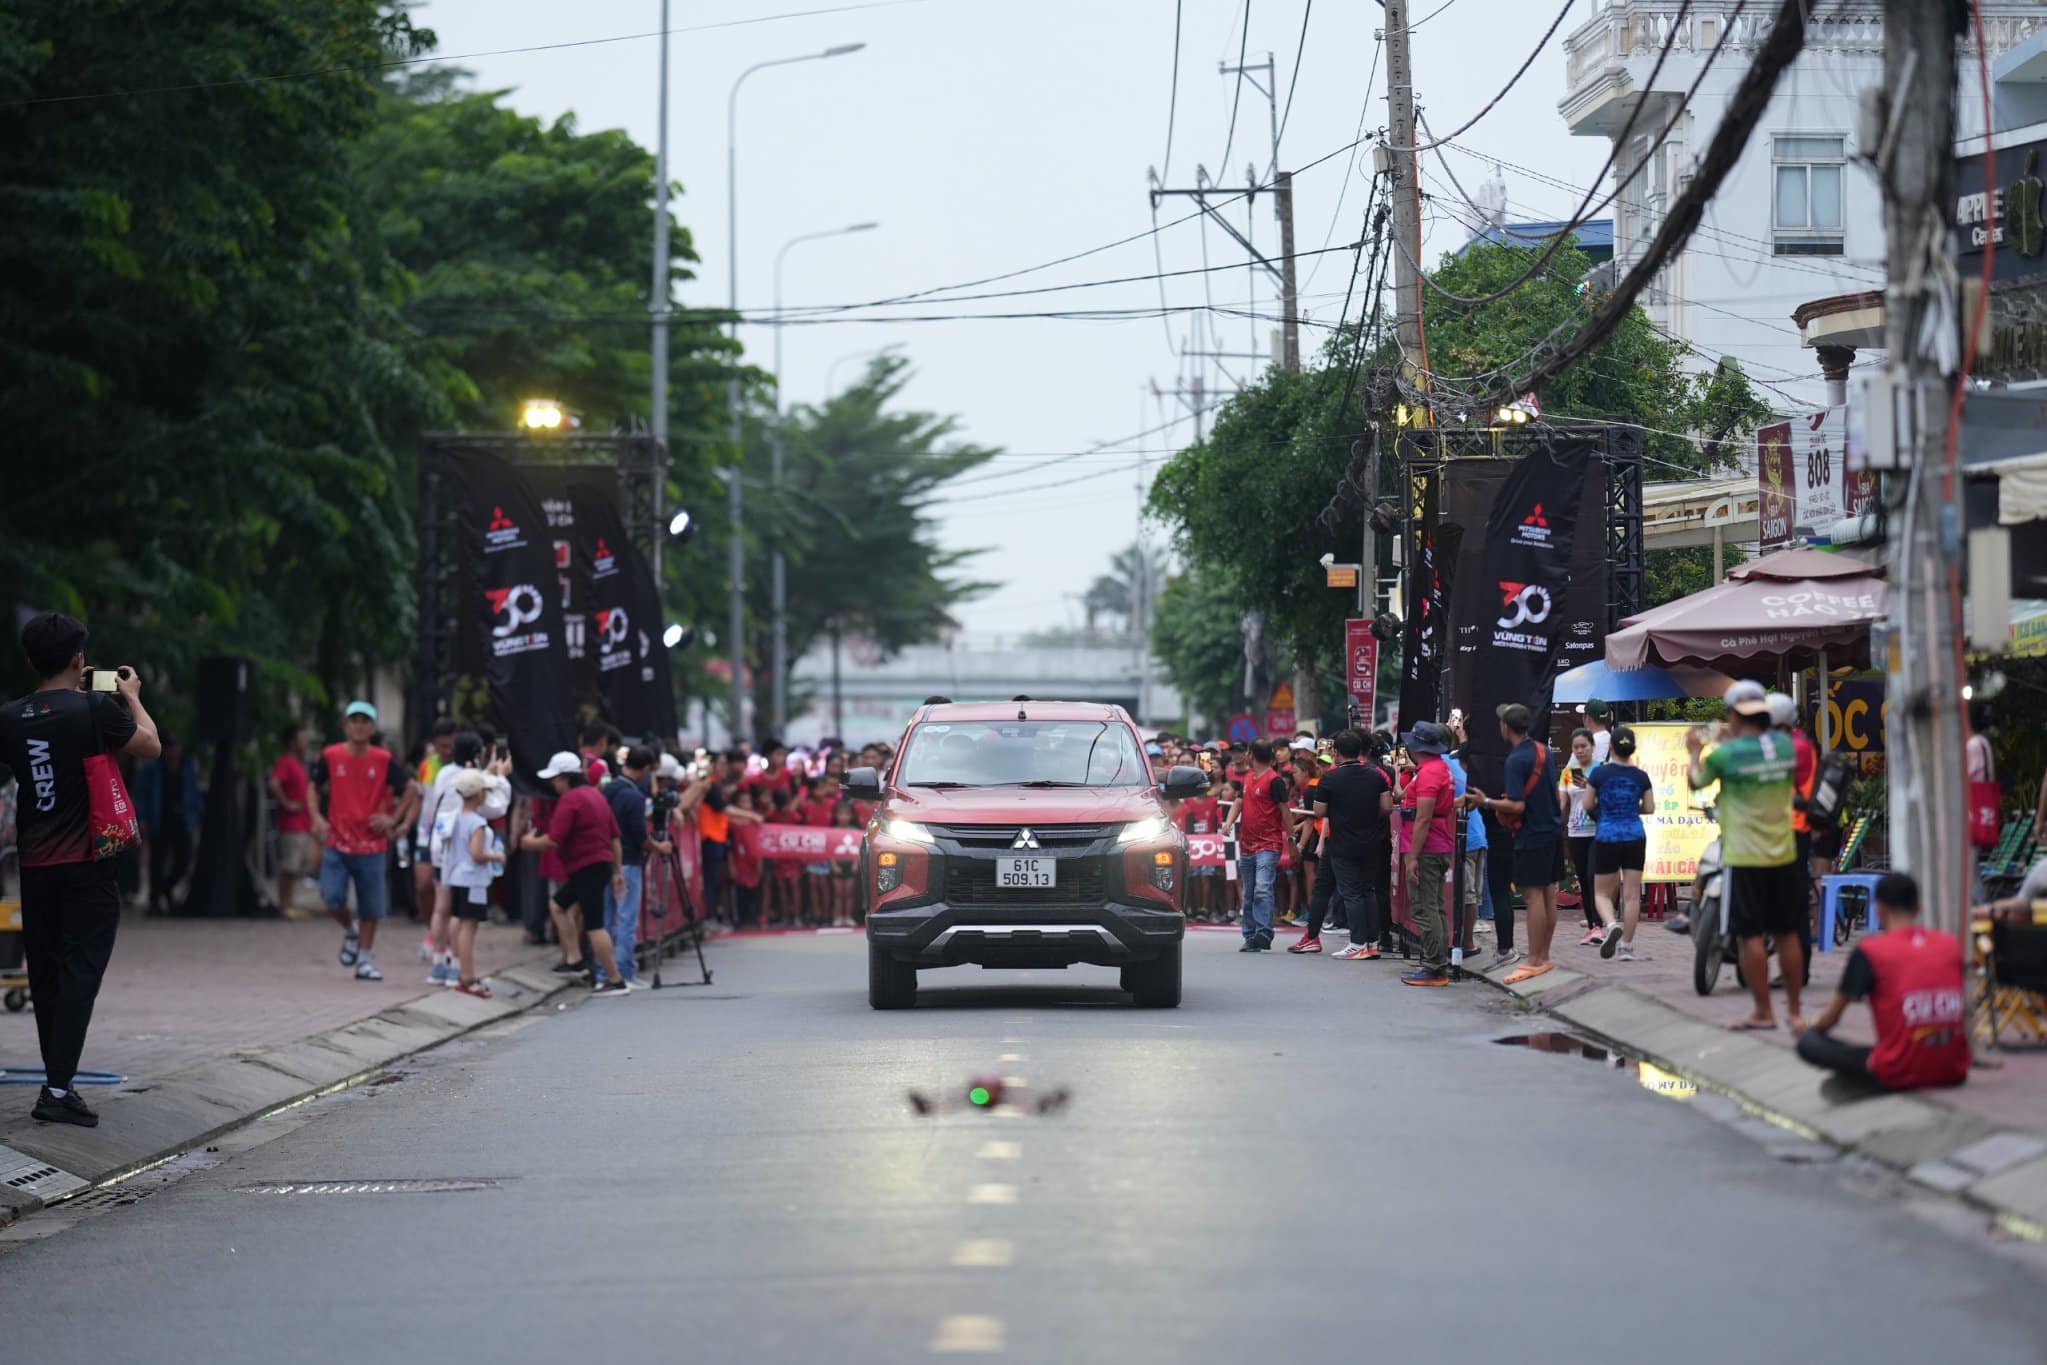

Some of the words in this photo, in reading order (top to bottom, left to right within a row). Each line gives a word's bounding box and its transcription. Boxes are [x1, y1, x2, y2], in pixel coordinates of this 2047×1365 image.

[1972, 227, 2003, 246] Ceer
[1808, 447, 1830, 489] 808
[1763, 517, 1787, 539] SAIGON
[1761, 591, 1875, 609] COFFEE
[1565, 641, 1595, 650] Salonpas
[1815, 681, 1869, 750] ỐC
[26, 739, 55, 812] CREW
[1014, 860, 1039, 872] 61C
[1003, 873, 1049, 886] 509.13
